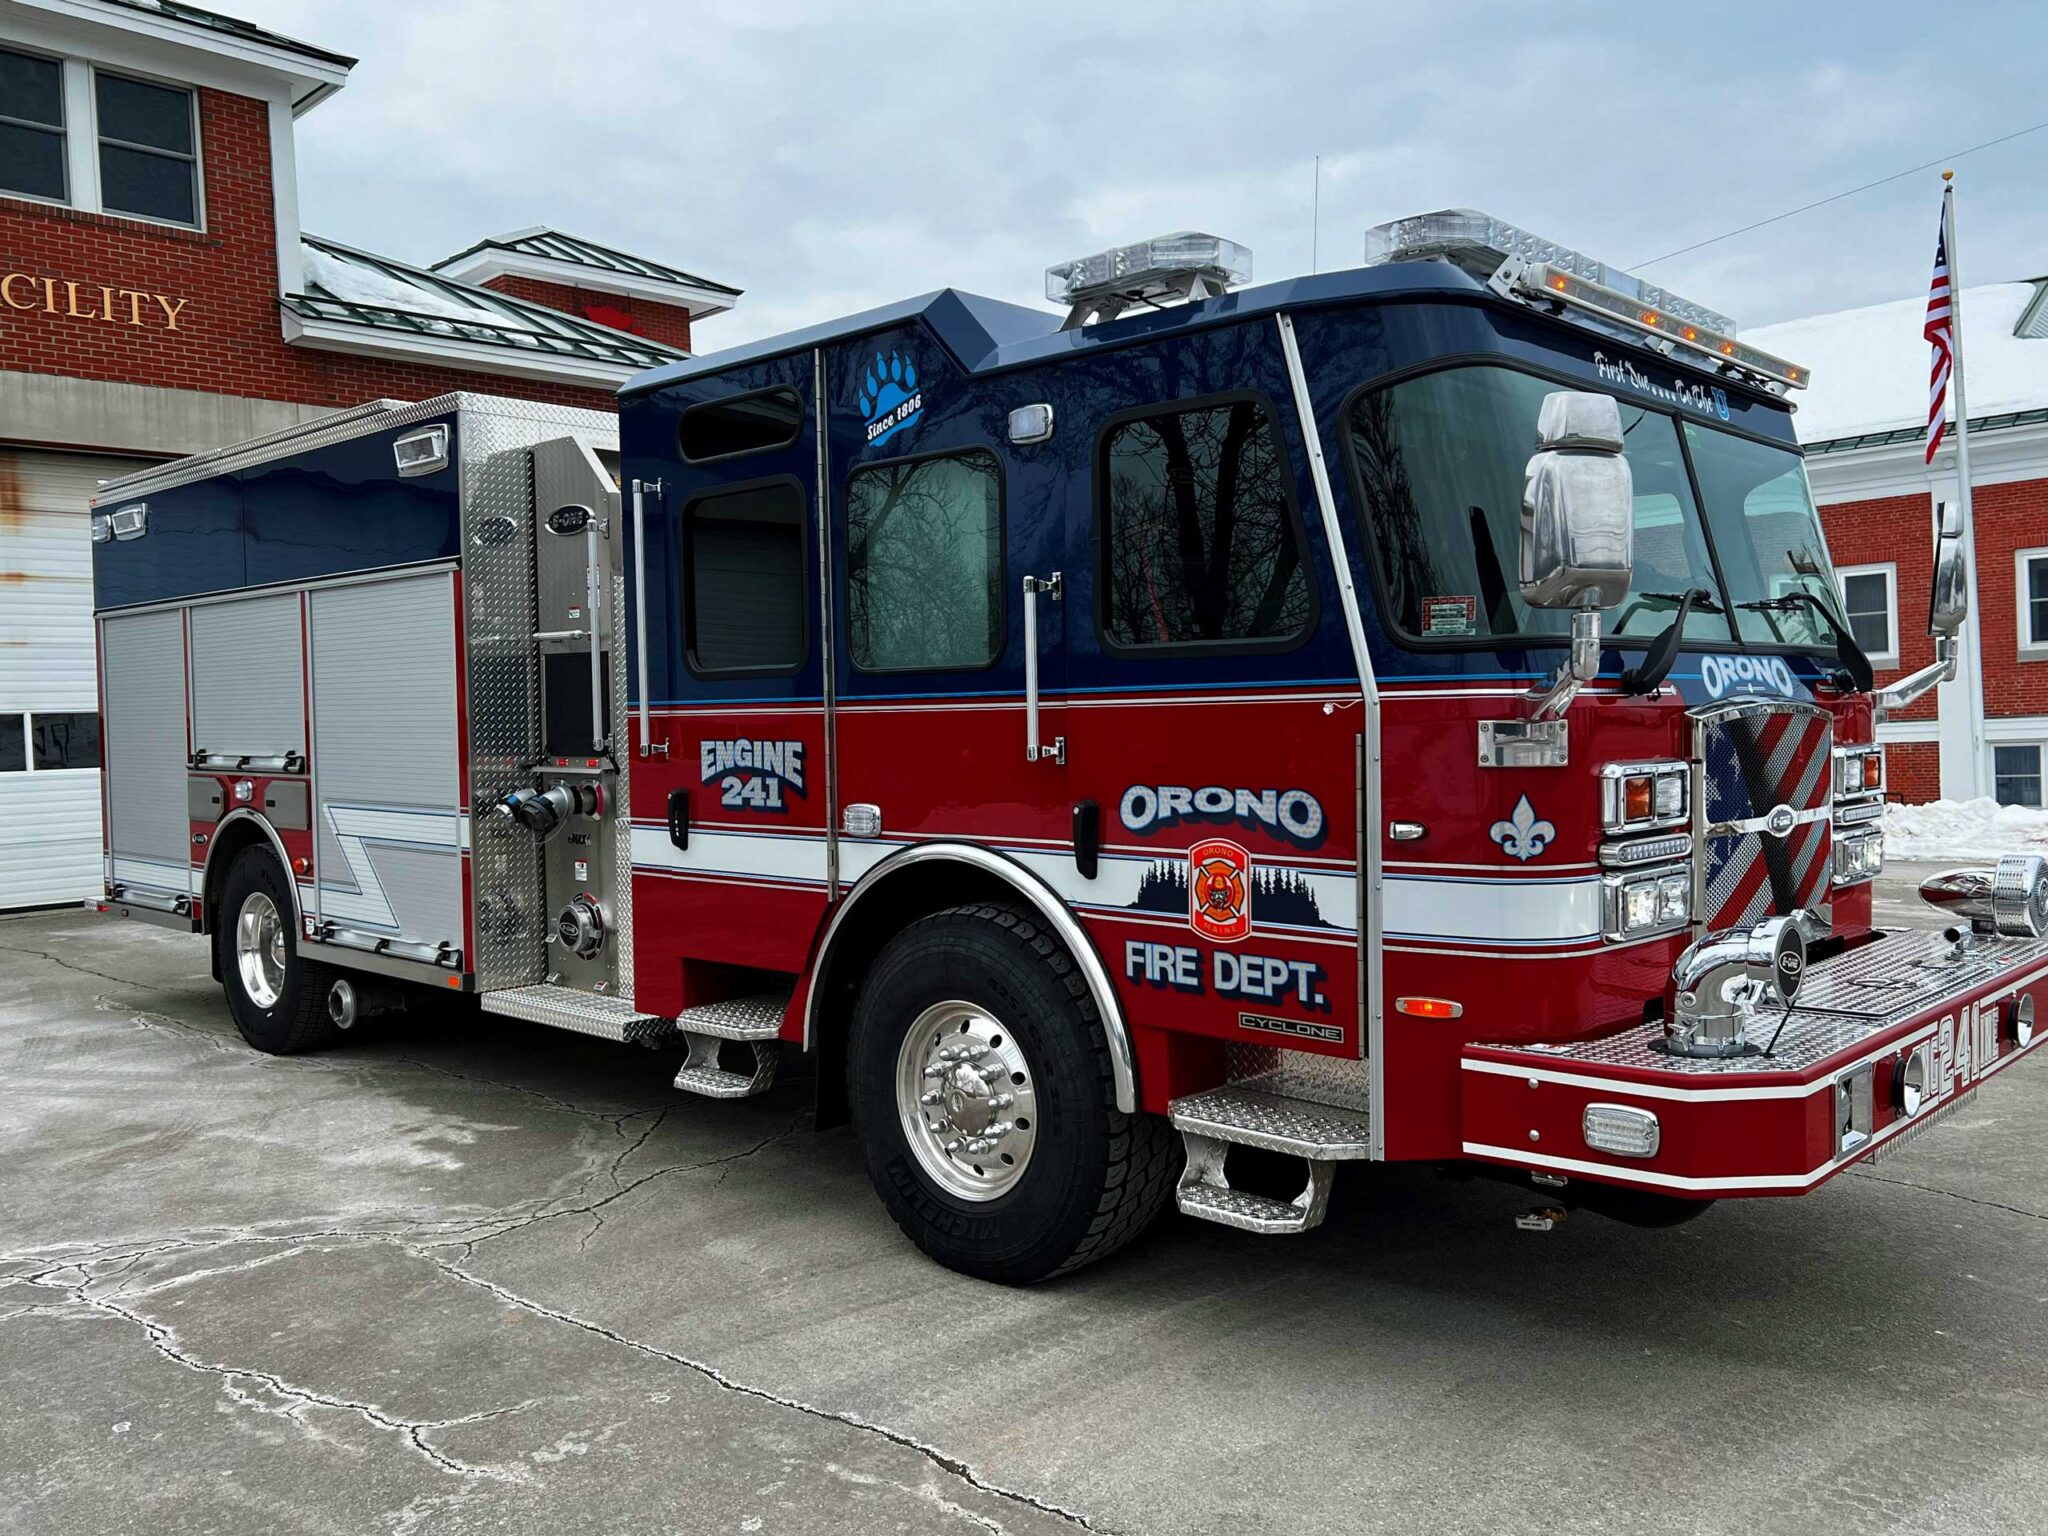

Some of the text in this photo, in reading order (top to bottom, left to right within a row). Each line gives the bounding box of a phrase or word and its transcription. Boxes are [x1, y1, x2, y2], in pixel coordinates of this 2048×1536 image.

[0, 273, 189, 331] CILITY
[867, 394, 922, 440] Since 1806
[1701, 654, 1794, 700] ORONO
[700, 738, 804, 791] ENGINE
[721, 775, 783, 809] 241
[1119, 784, 1324, 842] ORONO
[1202, 846, 1234, 858] ORONO
[1203, 923, 1238, 934] MAINE
[1125, 940, 1325, 1005] FIRE DEPT.
[1242, 1015, 1341, 1041] CYCLONE
